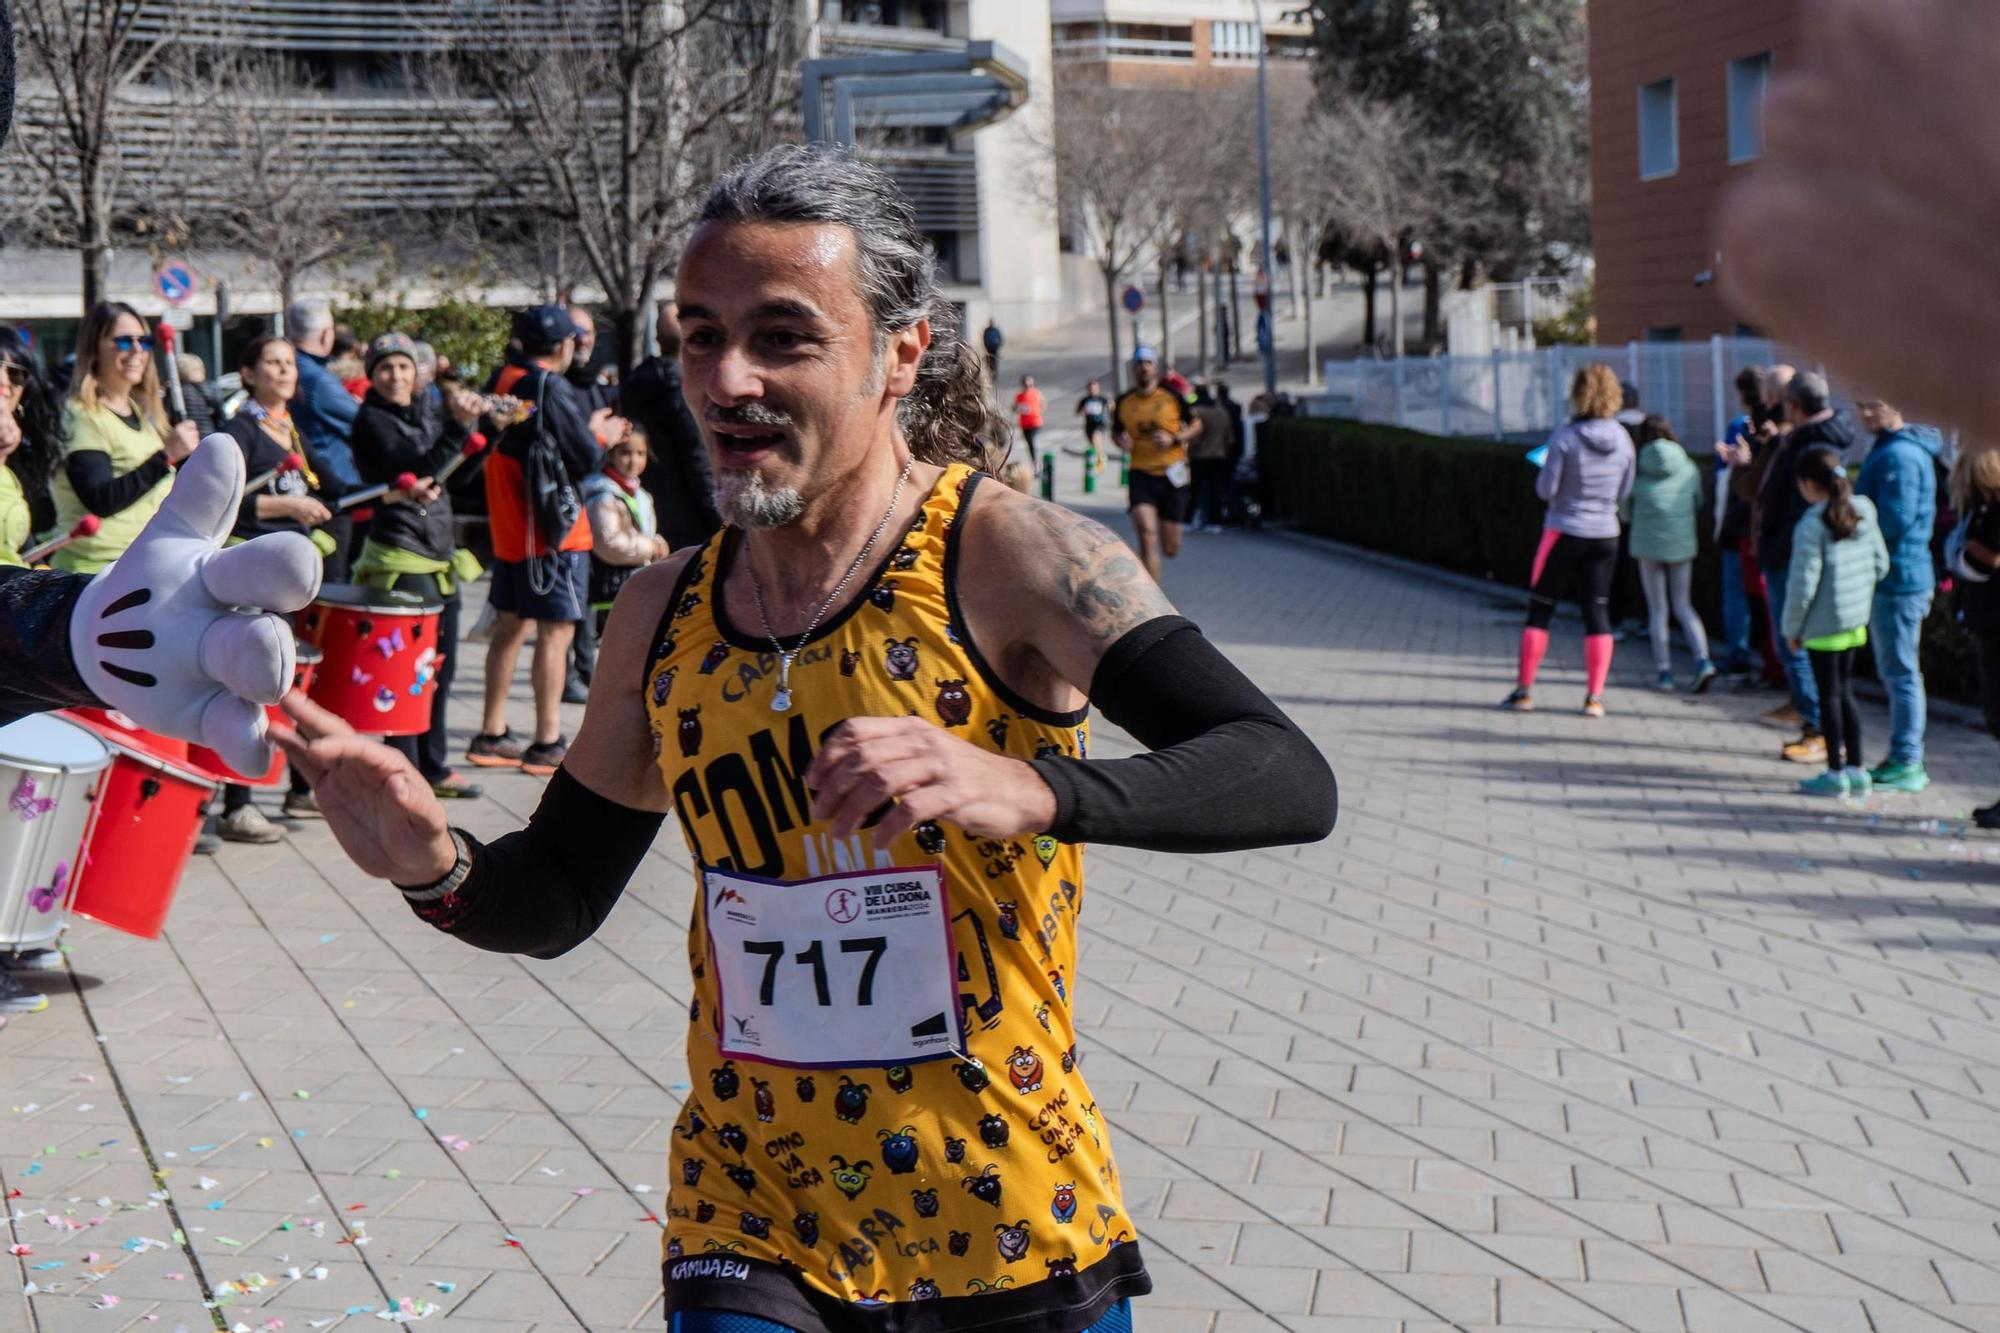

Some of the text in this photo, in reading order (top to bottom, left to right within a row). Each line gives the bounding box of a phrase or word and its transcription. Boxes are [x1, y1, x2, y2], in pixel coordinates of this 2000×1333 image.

[673, 713, 893, 880] COM
[865, 891, 932, 907] DE LA DONA
[884, 881, 923, 894] CURSA
[742, 936, 888, 1007] 717
[1027, 1088, 1070, 1132] COMO
[1040, 1114, 1069, 1145] UNA
[1047, 1121, 1085, 1164] CABRA
[827, 1208, 906, 1282] CABRA
[895, 1236, 940, 1257] LOCA
[671, 1258, 751, 1281] KAMUABU
